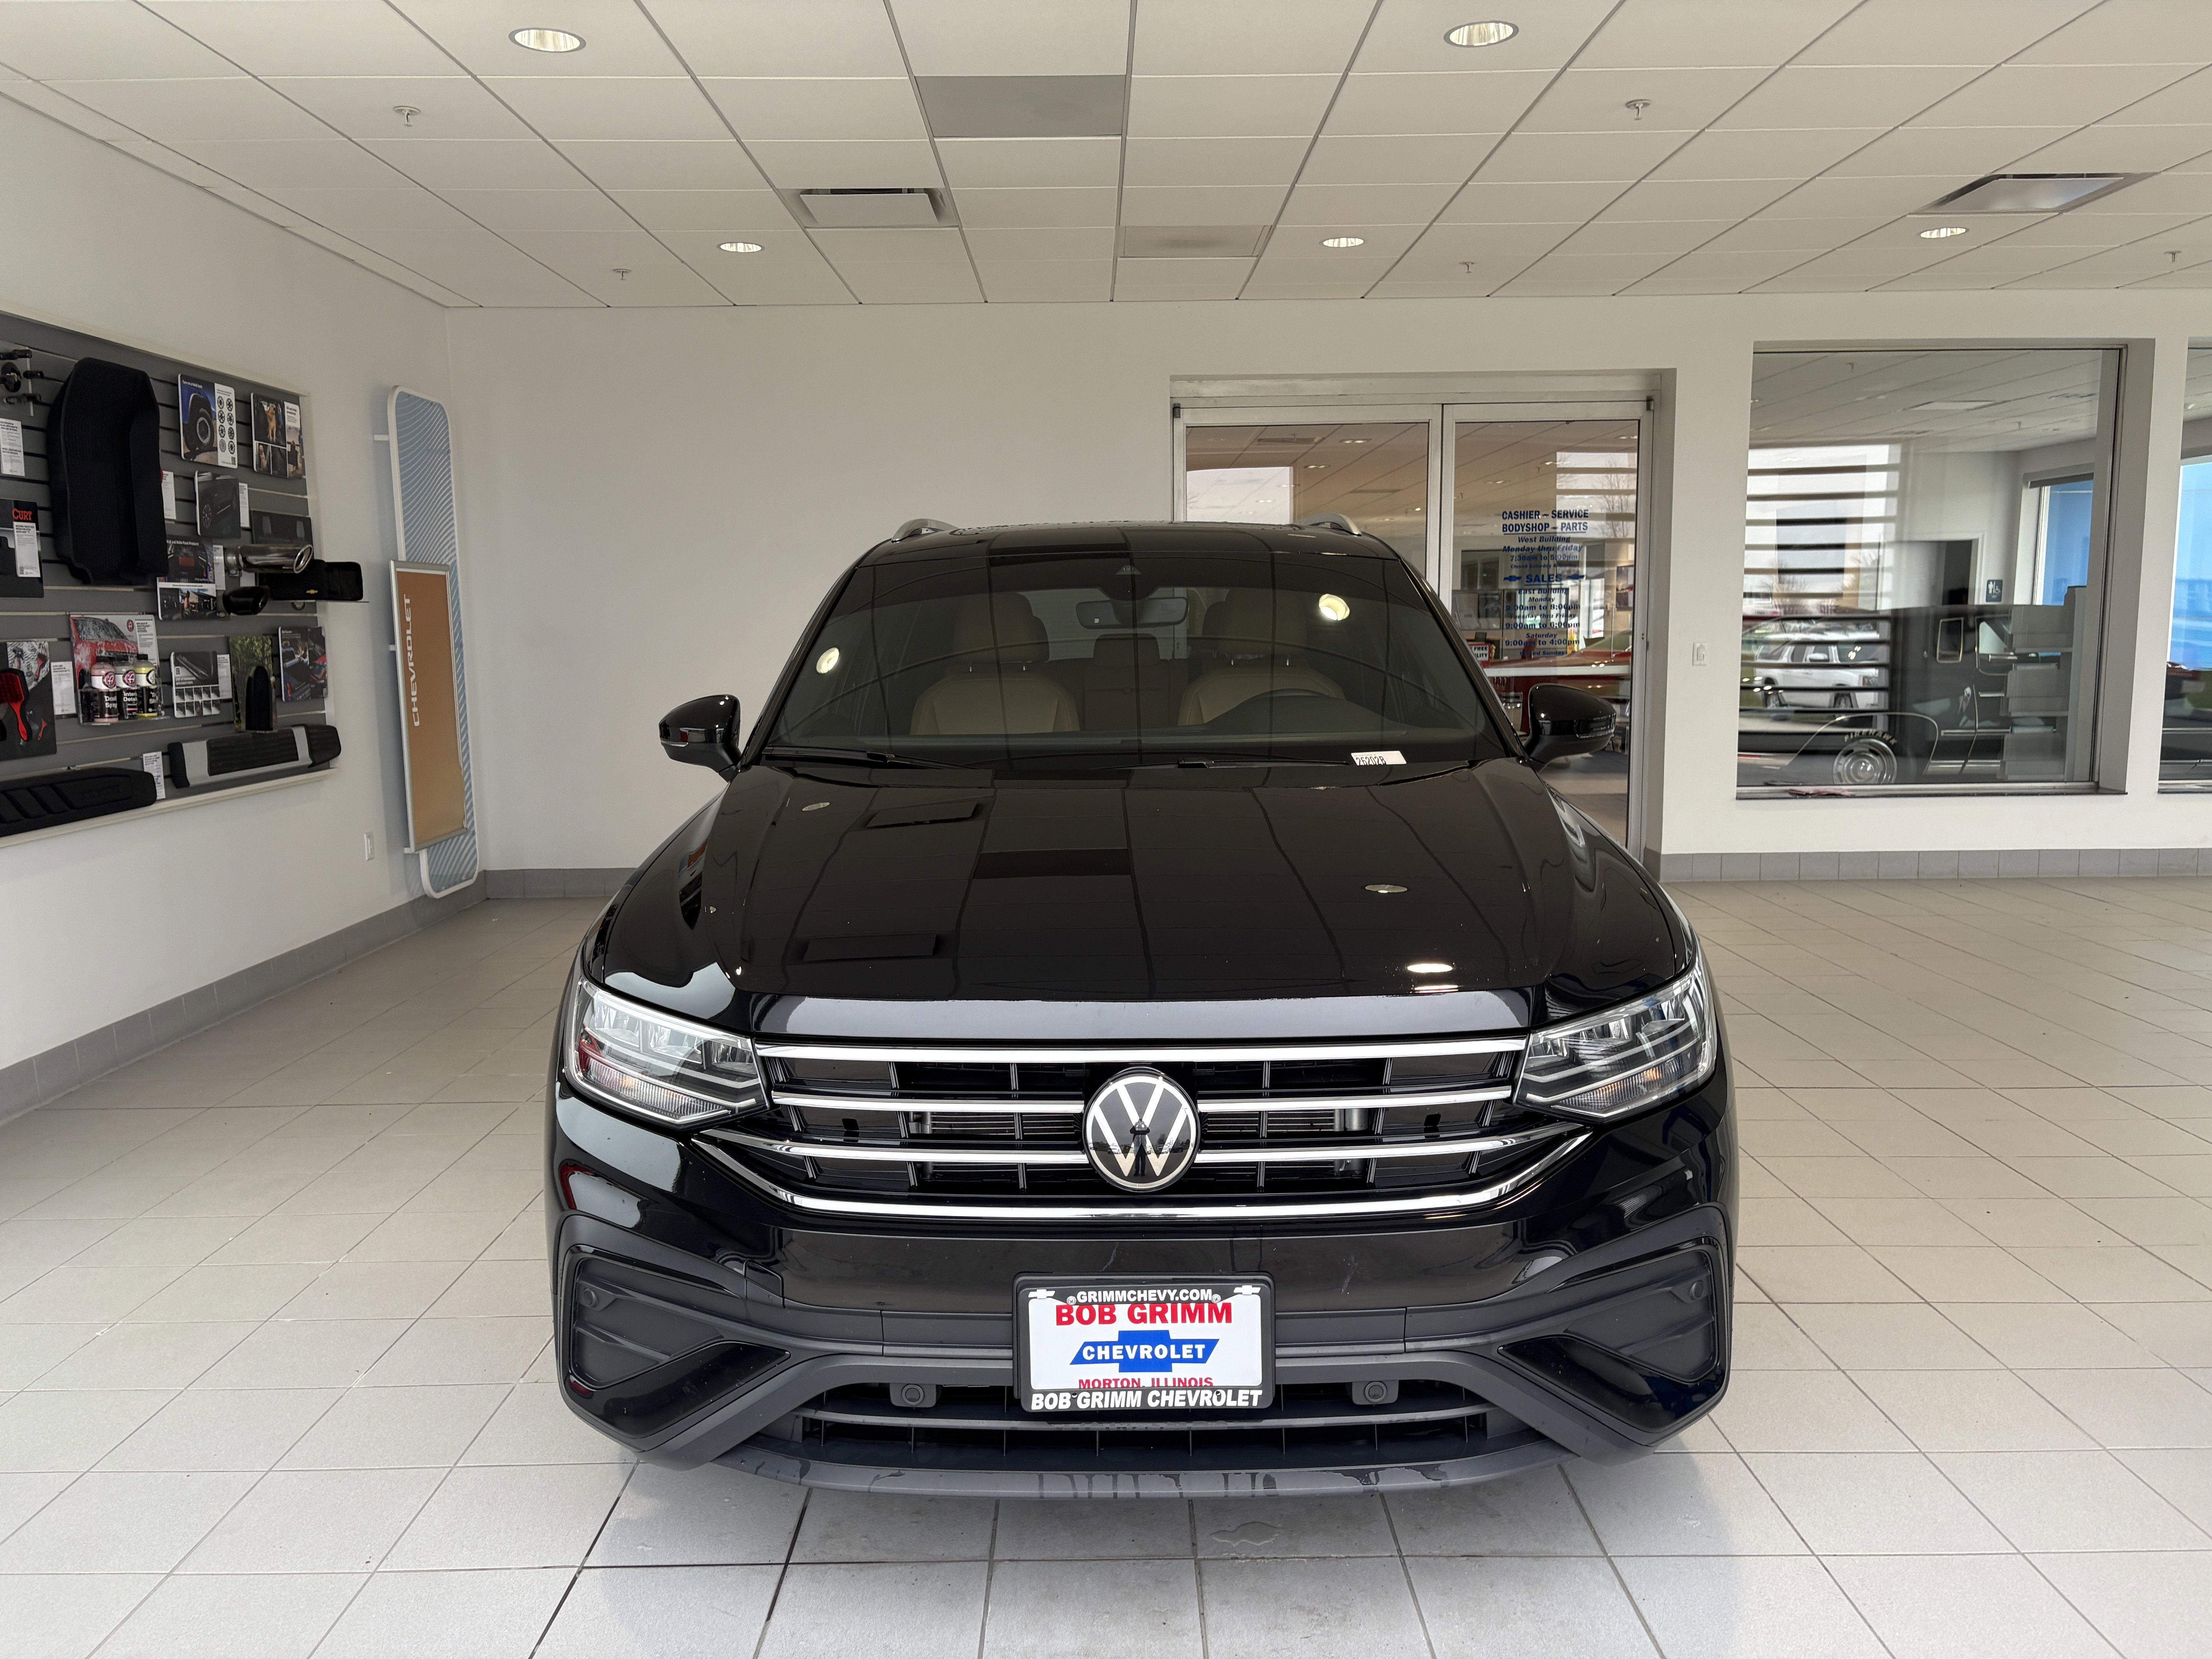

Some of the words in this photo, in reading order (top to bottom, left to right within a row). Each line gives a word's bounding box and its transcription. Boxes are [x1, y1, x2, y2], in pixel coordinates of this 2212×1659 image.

[13, 508, 32, 520] CURT
[1502, 510, 1540, 520] CASHIER
[1552, 509, 1589, 519] SERVICE
[1502, 523, 1549, 532] BODYSHOP
[1561, 522, 1588, 531] PARTS
[1526, 574, 1562, 582] SALES
[404, 594, 420, 726] CHEVROLET
[1077, 1289, 1212, 1303] GRIMMCHEVY.COM
[1056, 1304, 1117, 1326] BOB
[1127, 1303, 1232, 1324] GRIMM
[1082, 1344, 1206, 1360] CHEVROLET
[1152, 1377, 1213, 1387] ILLINOIS
[1031, 1392, 1072, 1410] BOB
[1076, 1390, 1142, 1408] GRIMM
[1147, 1389, 1262, 1407] CHEVROLET
